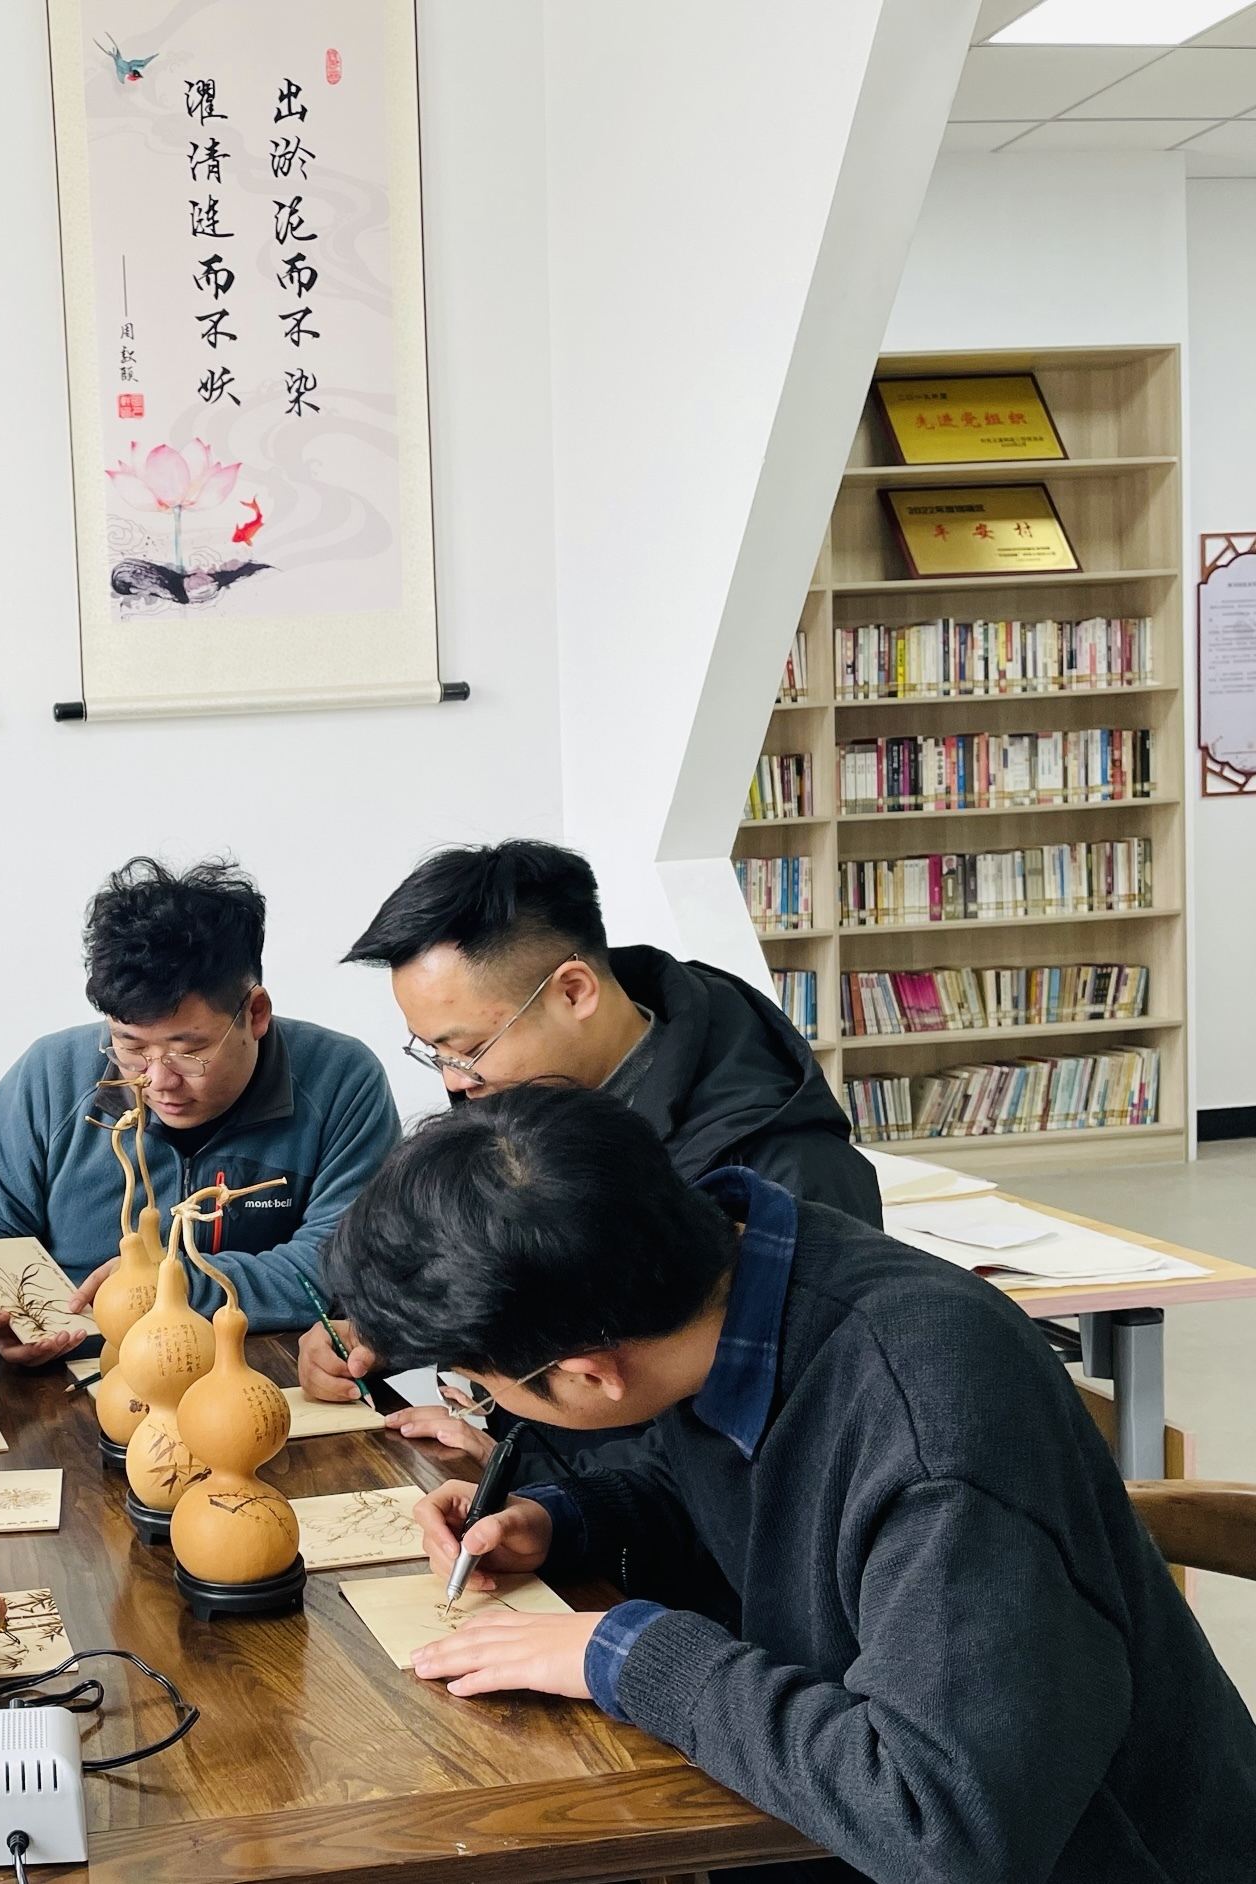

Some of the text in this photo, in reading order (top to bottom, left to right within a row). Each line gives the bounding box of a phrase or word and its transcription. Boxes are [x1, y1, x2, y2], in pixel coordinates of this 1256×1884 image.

[184, 78, 241, 407] 濯清涟而不妖
[269, 77, 321, 418] 出淤泥而不染
